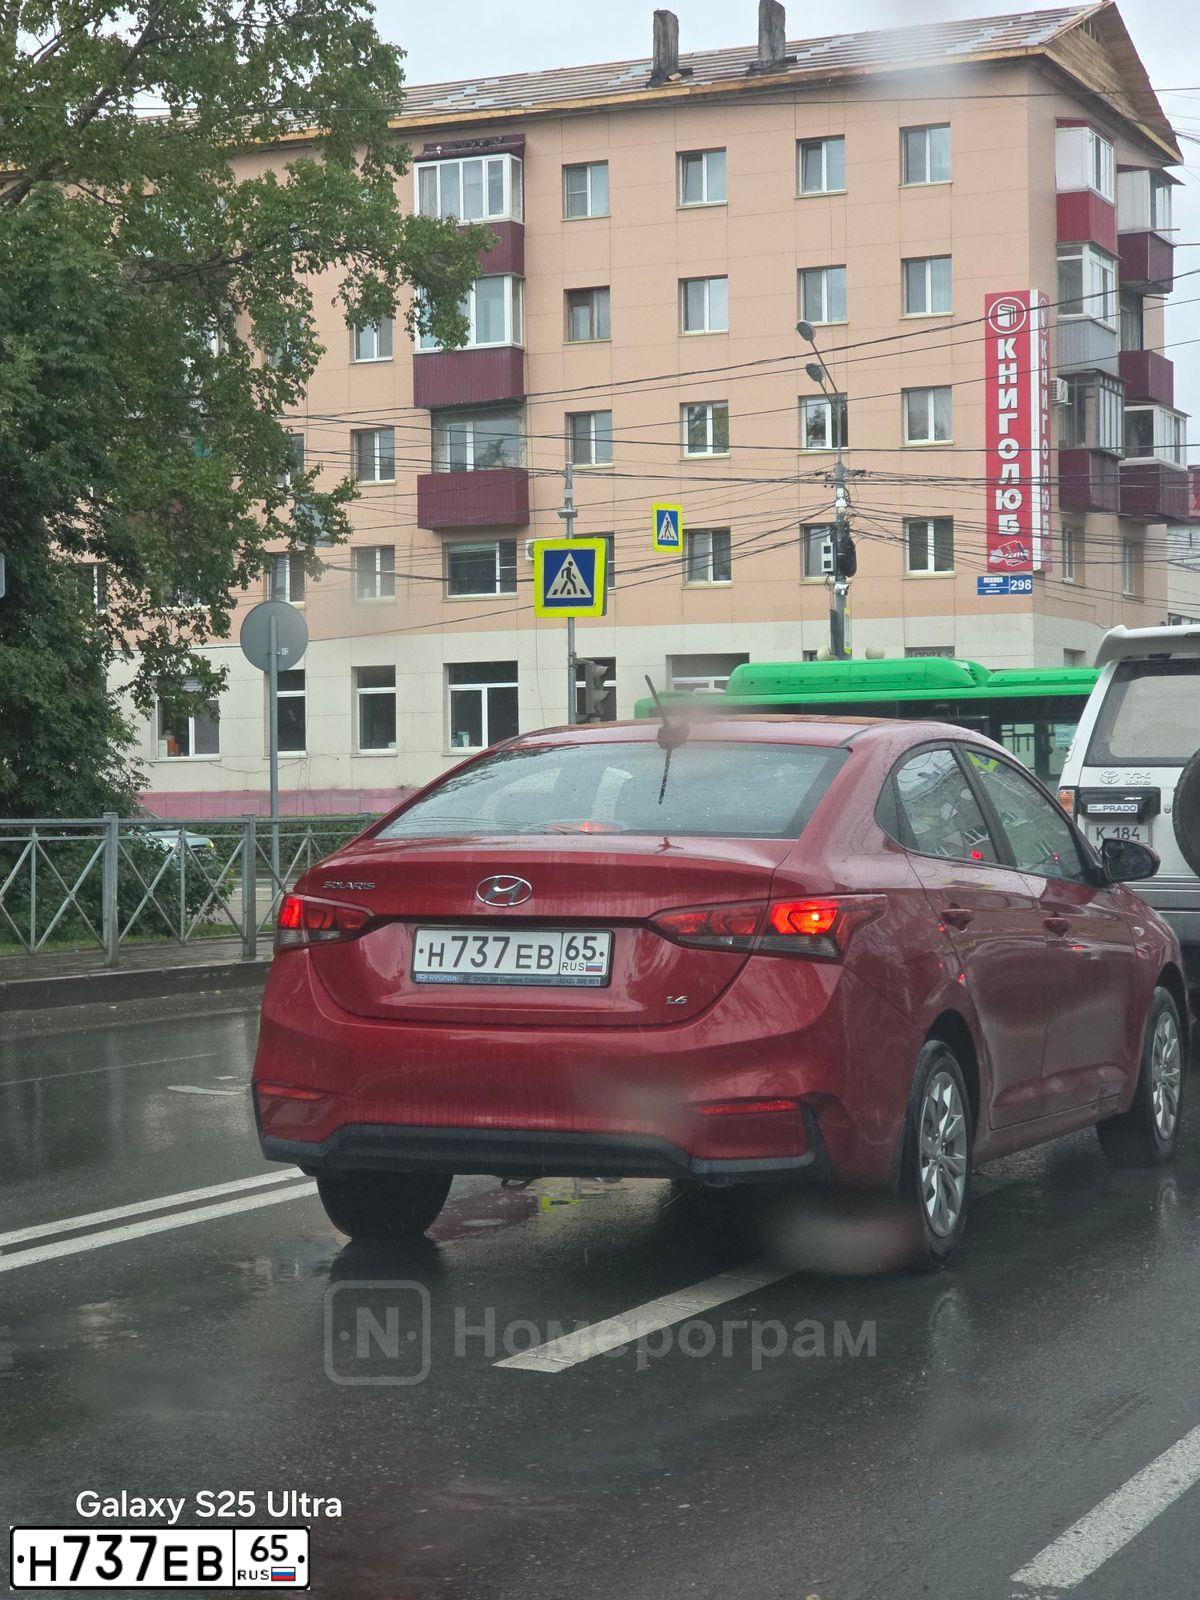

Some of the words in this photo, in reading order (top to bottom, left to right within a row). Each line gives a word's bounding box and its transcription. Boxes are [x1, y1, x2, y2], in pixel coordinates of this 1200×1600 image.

[995, 338, 1023, 536] КНИГОЛЮБ
[1010, 579, 1032, 591] 298
[1103, 804, 1137, 812] PRADO
[322, 880, 376, 890] SOLARIS
[565, 936, 597, 961] 65
[562, 962, 584, 972] RUS
